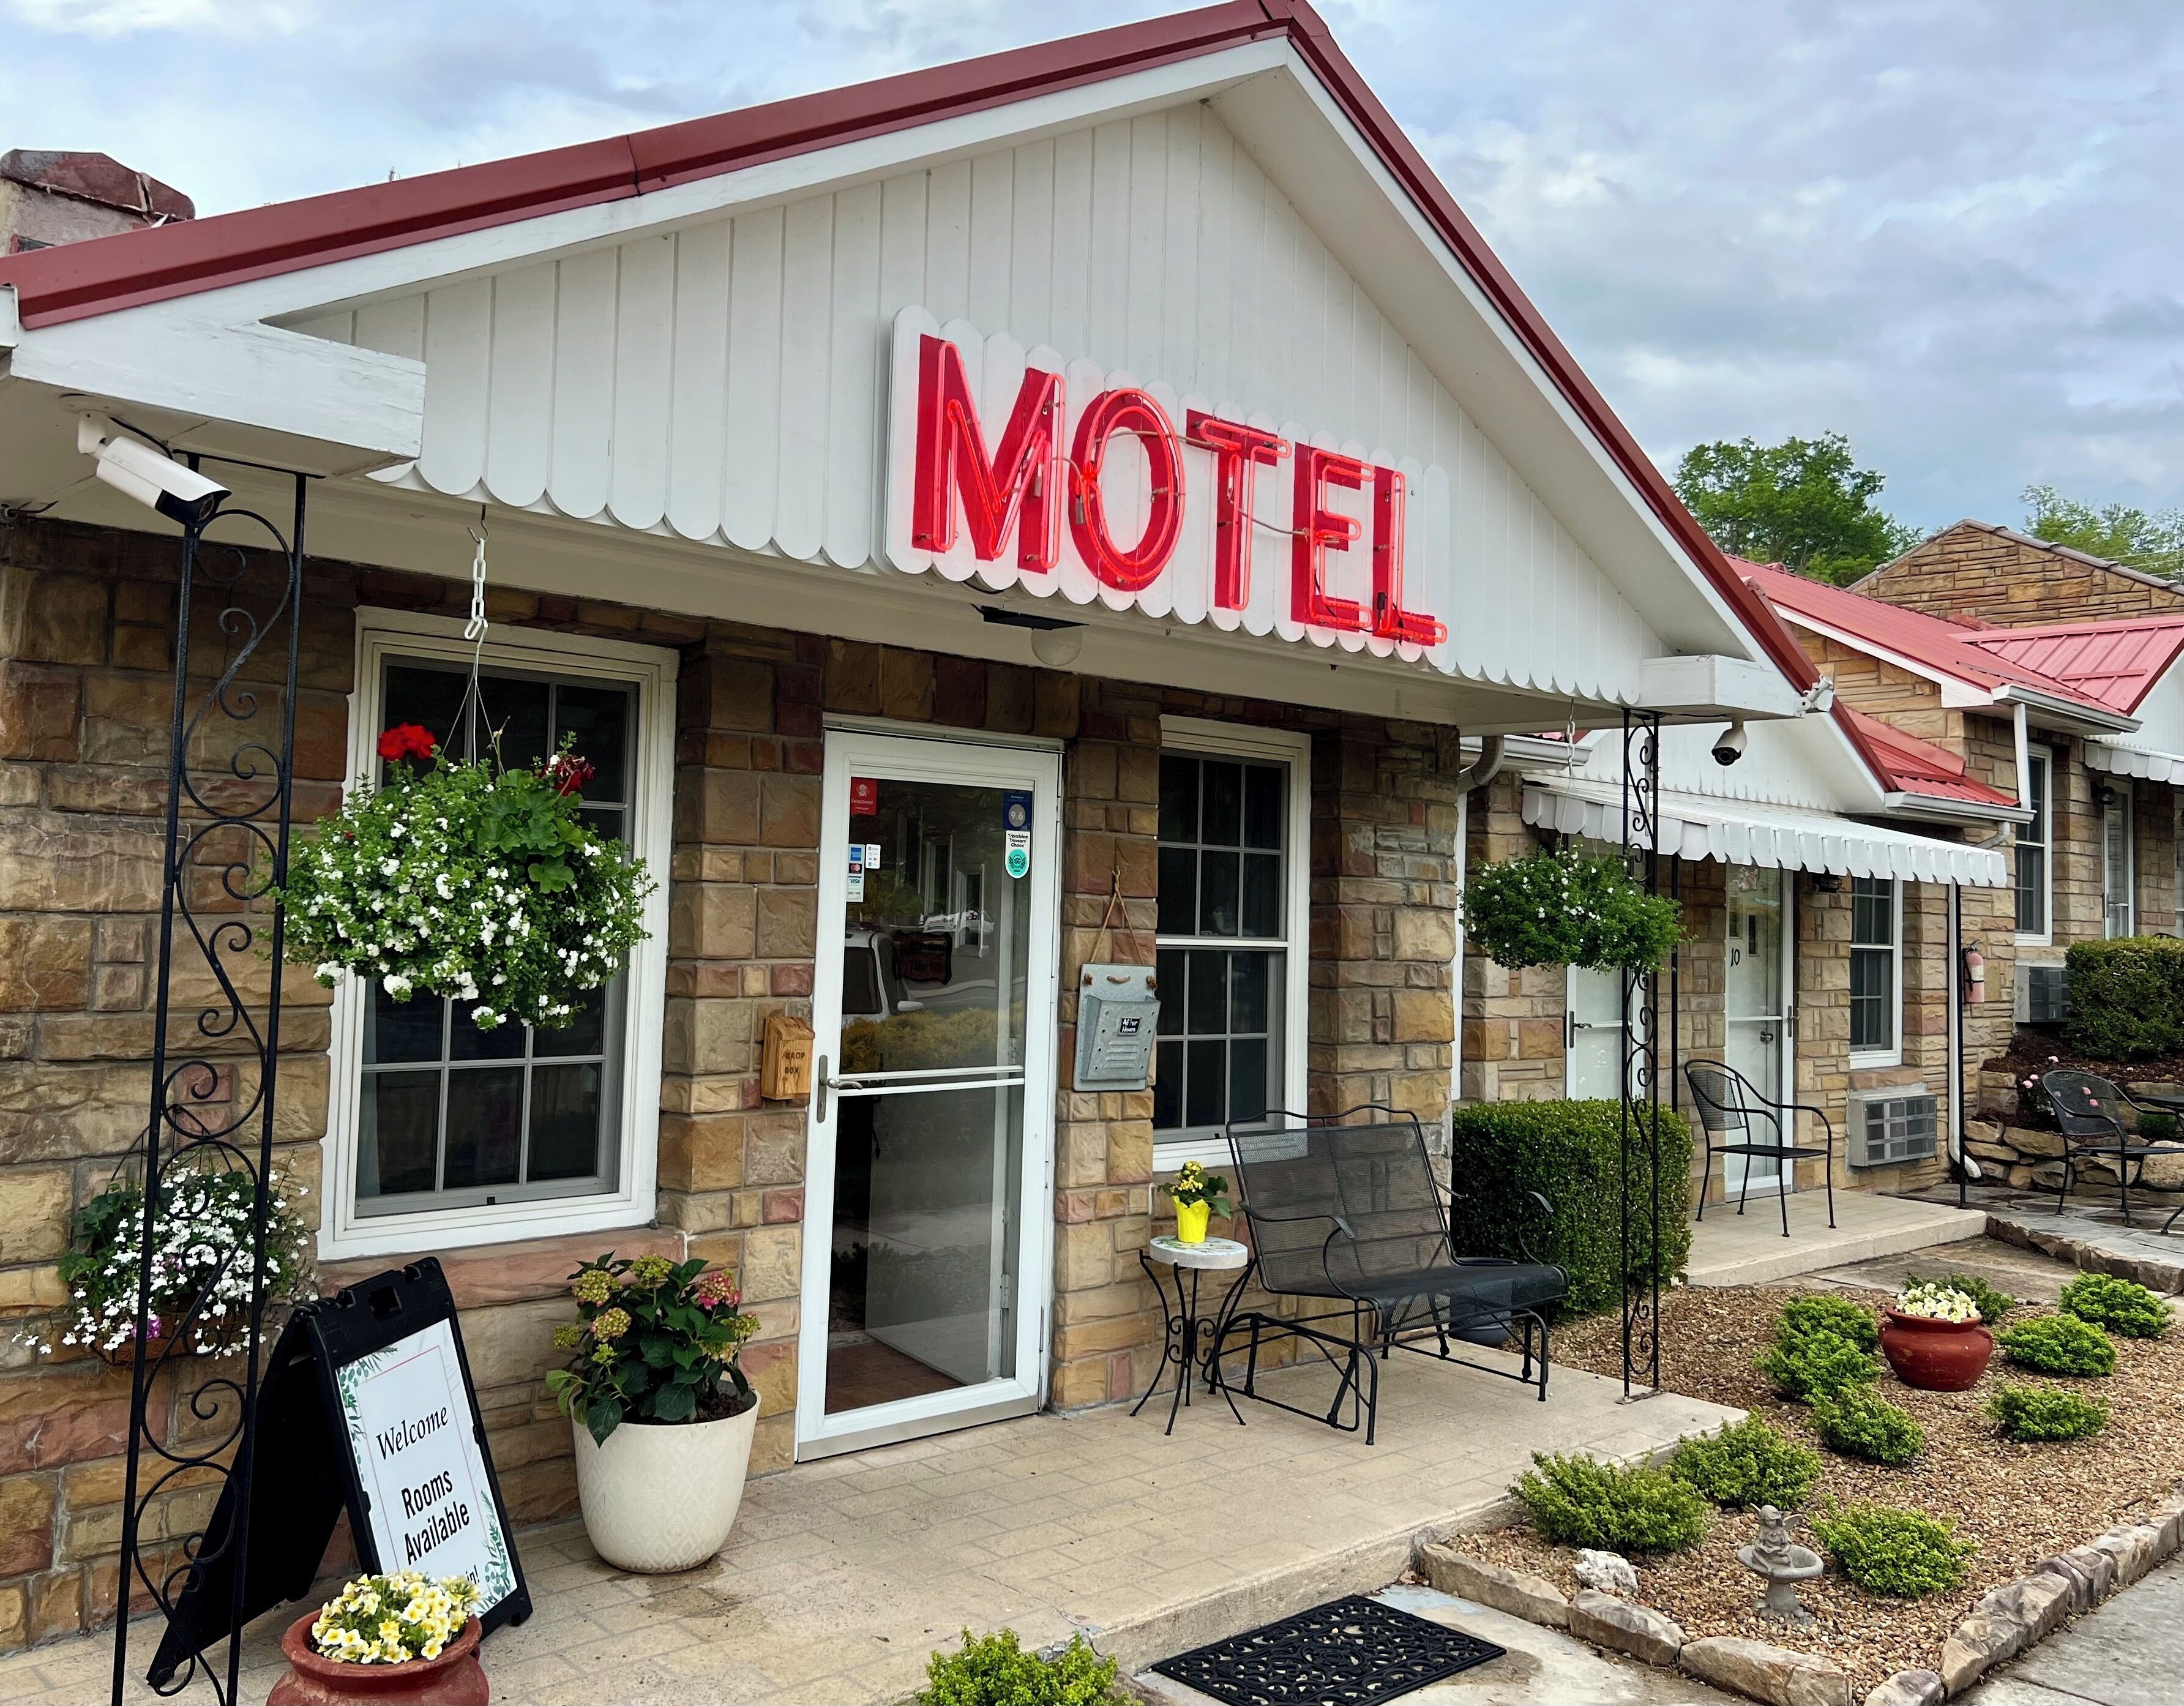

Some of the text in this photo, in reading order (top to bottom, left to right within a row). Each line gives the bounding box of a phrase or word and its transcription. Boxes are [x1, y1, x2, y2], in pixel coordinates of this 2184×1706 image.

[912, 334, 1447, 646] MOTEL
[1011, 811, 1023, 820] 9.6
[1730, 948, 1740, 967] 10
[376, 1407, 448, 1460] Welcome
[401, 1470, 453, 1519] Rooms
[405, 1501, 469, 1566] Available
